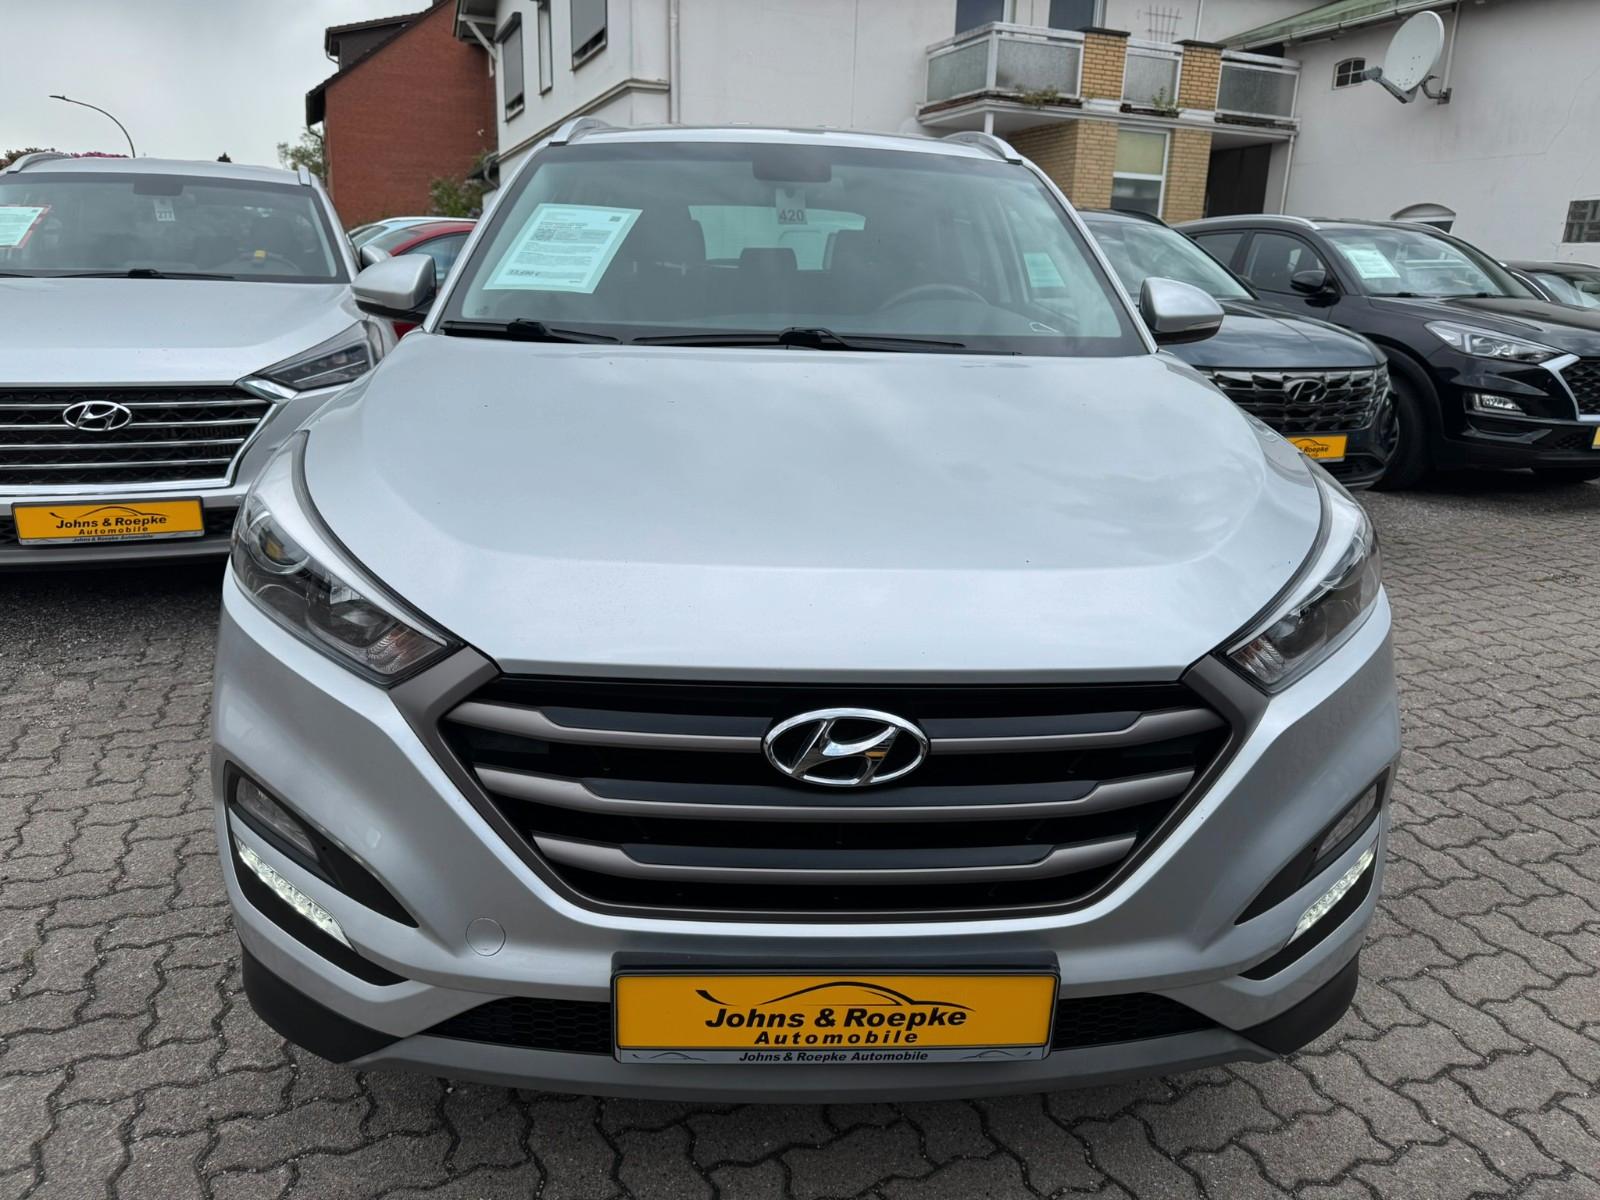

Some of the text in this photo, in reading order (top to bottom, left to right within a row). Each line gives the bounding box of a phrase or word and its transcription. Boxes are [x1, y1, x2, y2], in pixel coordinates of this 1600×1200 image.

[779, 209, 805, 222] 420
[56, 515, 167, 529] Johns & Roepke
[79, 526, 149, 535] Automobile
[705, 1007, 967, 1032] Johns & Roepke
[754, 1030, 918, 1045] Automobile
[739, 1051, 929, 1063] Johns & Roepke Automobile
